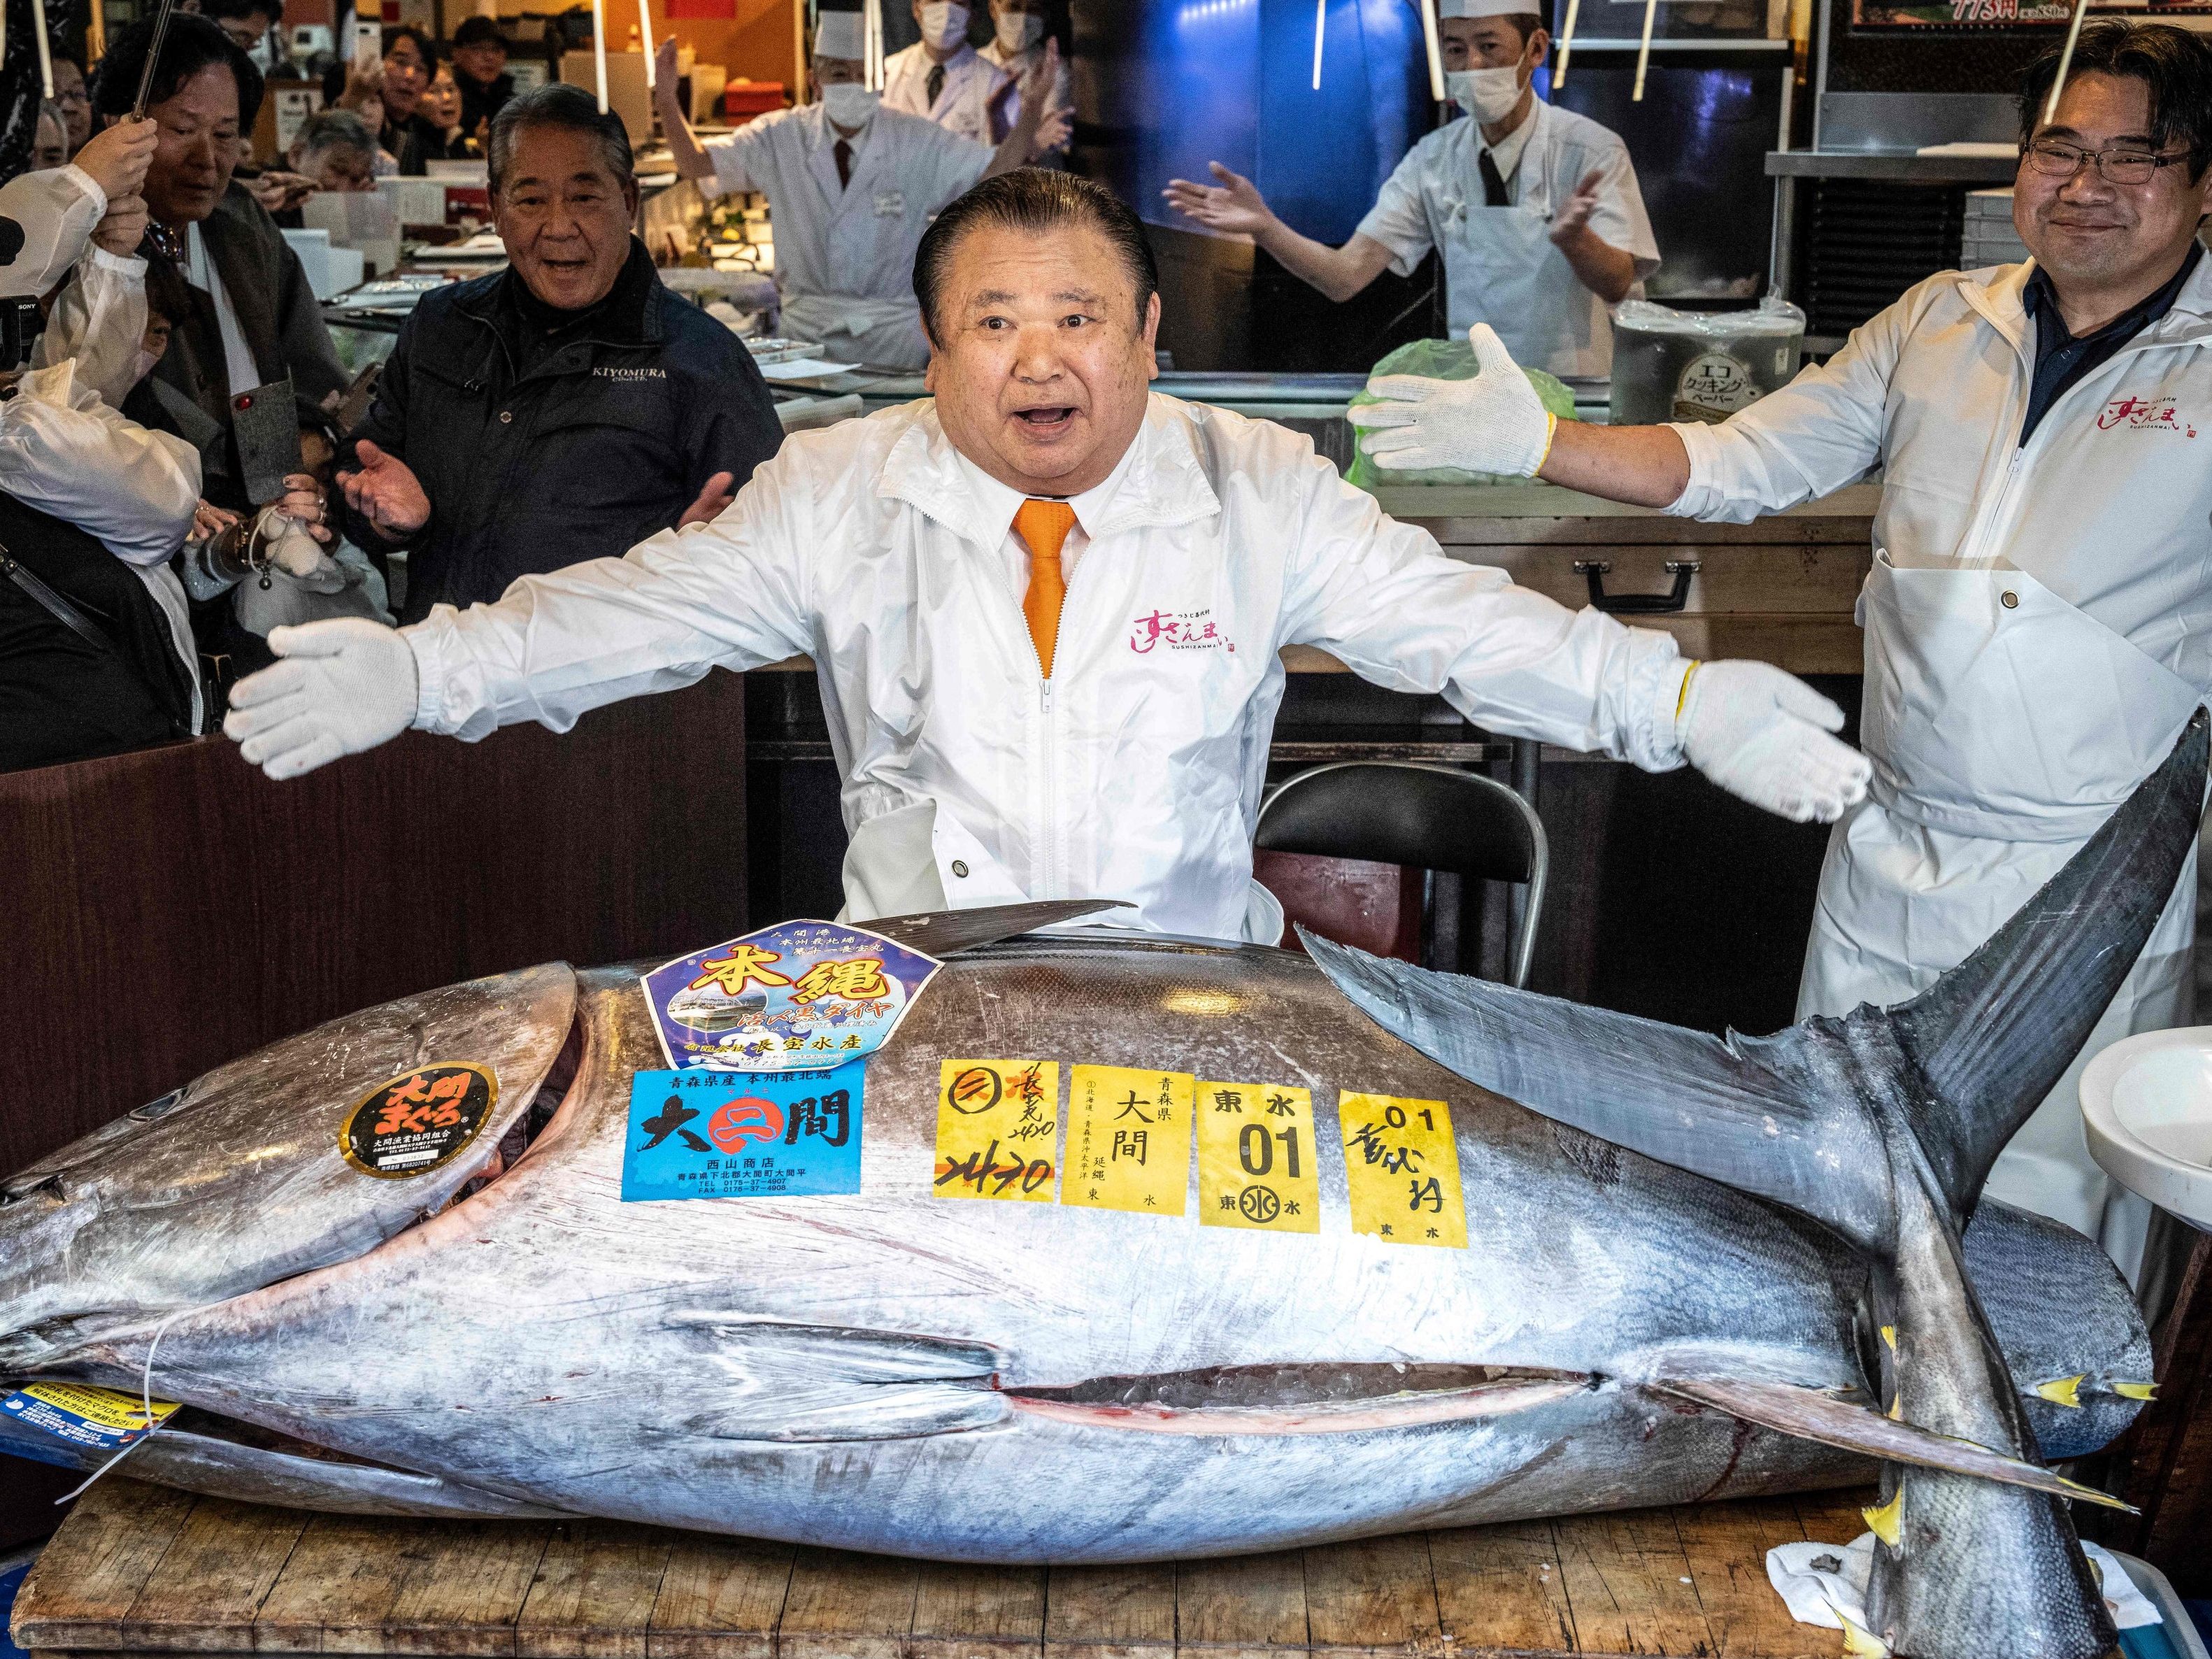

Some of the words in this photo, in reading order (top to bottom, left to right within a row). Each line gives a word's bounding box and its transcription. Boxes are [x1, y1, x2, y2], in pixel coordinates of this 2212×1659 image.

[592, 367, 666, 378] KIYOMURA
[1699, 364, 1731, 378] エコ
[1685, 375, 1746, 393] クッキング
[1692, 394, 1734, 403] ペーパー
[1178, 608, 1210, 618] つきじ喜代村
[779, 936, 855, 946] 本州最北端
[792, 944, 884, 957] 第十一長宝丸
[690, 945, 889, 1004] 本縄
[684, 1042, 746, 1053] 有限会社
[752, 1034, 862, 1053] 長宝水産
[669, 1076, 736, 1088] 青森県産
[746, 1070, 832, 1085] 本州最北端
[386, 1072, 471, 1106] 大間
[1157, 1077, 1173, 1120] 青森県
[375, 1099, 461, 1134] まぐろ
[1385, 1106, 1434, 1131] 01
[1112, 1090, 1154, 1166] 大間
[373, 1129, 451, 1147] 大間漁業協同組合
[1239, 1124, 1301, 1178] 01
[707, 1158, 776, 1170] 西山商店
[1092, 1157, 1106, 1181] 延縄
[678, 1169, 806, 1181] 青森県下北郡大間町大間平
[31, 1388, 134, 1426] 解体された方はご連絡ください
[40, 1383, 120, 1416] この札を付けたマグロを
